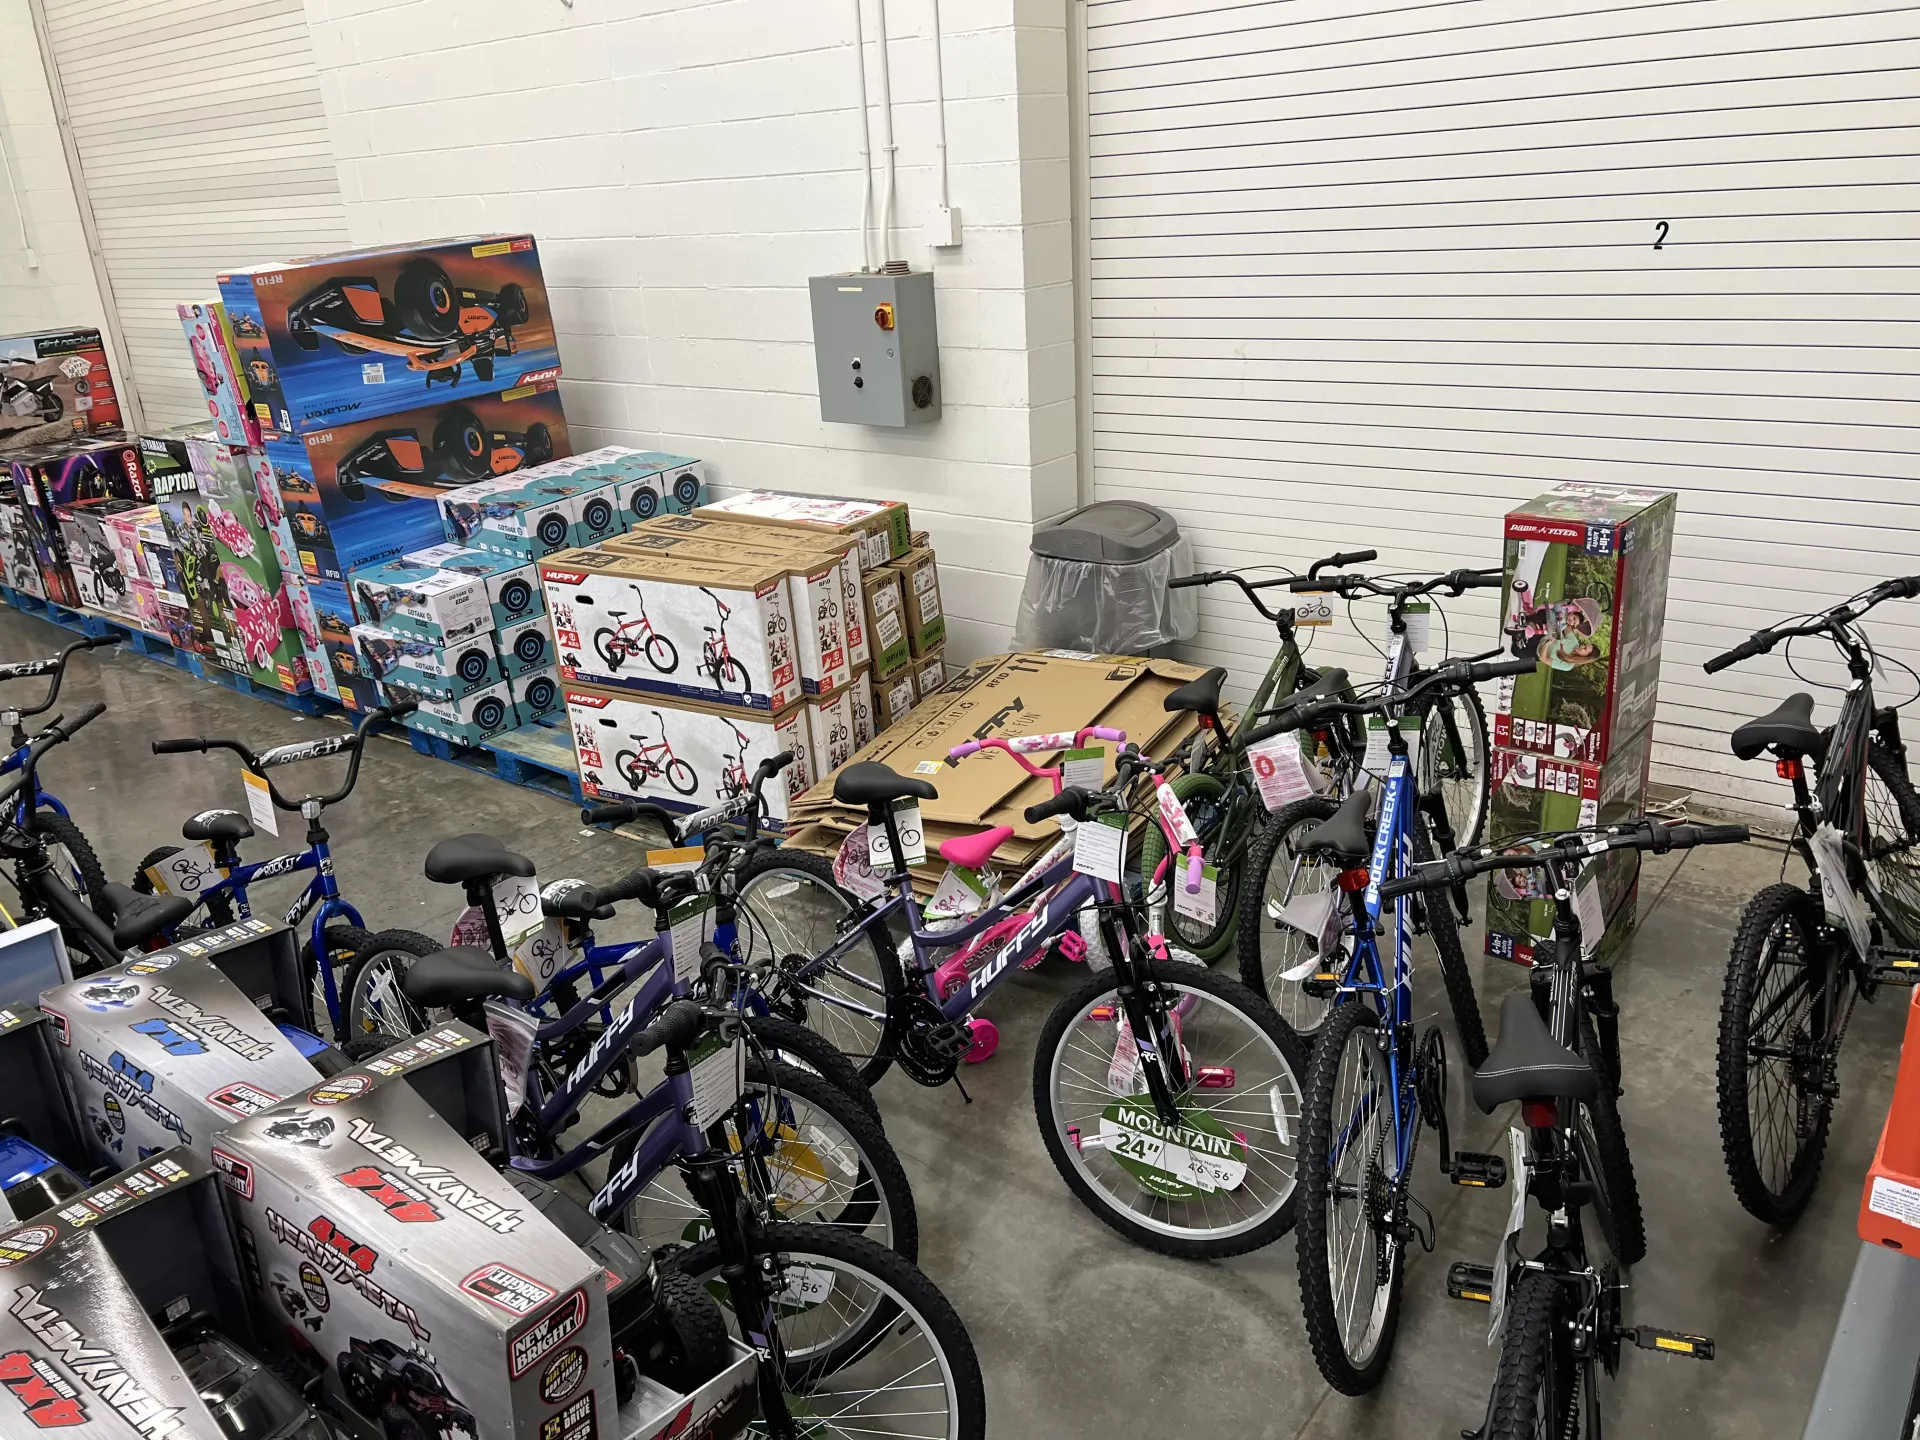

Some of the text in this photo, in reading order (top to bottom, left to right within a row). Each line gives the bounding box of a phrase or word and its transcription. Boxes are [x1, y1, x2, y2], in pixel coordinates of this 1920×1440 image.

[1653, 220, 1670, 251] 2
[256, 274, 283, 286] RFID
[523, 369, 557, 384] HUFFY
[305, 401, 362, 419] McLaren
[309, 433, 333, 446] RFID
[127, 462, 143, 499] Razor
[153, 472, 196, 494] RAPTOR
[504, 534, 518, 542] EDGE
[1509, 524, 1579, 537] RADIO FLYER
[1599, 528, 1611, 554] 4-in-1
[353, 545, 404, 567] McLaren
[918, 557, 930, 569] RFID
[325, 569, 340, 579] RFID
[546, 571, 579, 581] HUFFY
[809, 570, 828, 582] HUFFY
[758, 584, 775, 598] HUFFY
[819, 579, 831, 588] RFID
[877, 578, 893, 590] RFID
[455, 596, 470, 605] EDGE
[925, 636, 943, 653] HUFFY
[831, 659, 842, 669] BUILD
[886, 660, 907, 677] HUFFY
[577, 674, 592, 683] ROCK
[782, 672, 793, 683] BUILD
[985, 672, 1010, 689] RFID
[1381, 656, 1396, 697] CREEK
[569, 694, 603, 705] HUFFY
[822, 698, 840, 710] HUFFY
[777, 717, 794, 731] HUFFY
[1014, 711, 1042, 728] FUN
[1499, 725, 1509, 736] 1-5
[279, 742, 344, 765] ROCK IT
[1584, 777, 1594, 789] 1-5
[699, 800, 748, 832] ROCK IT
[1369, 846, 1387, 894] ROCK
[1378, 790, 1398, 847] CREEK
[264, 857, 297, 877] ROCK IT
[1076, 862, 1096, 872] HUFFY
[1177, 902, 1193, 912] HUFFY
[671, 911, 695, 924] MOUNTAIN
[970, 904, 1050, 999] HUFFY
[1492, 933, 1501, 955] 4-in-1
[677, 965, 693, 977] HUFFY
[148, 984, 275, 1062] HEAVY METAL
[566, 998, 635, 1094] HUFFY
[690, 1047, 717, 1066] MOUNTAIN
[79, 1049, 192, 1145] HEAVY METAL
[701, 1108, 720, 1125] HUFFY
[1117, 1106, 1232, 1157] MOUNTAIN
[1116, 1132, 1161, 1160] 24"
[214, 1155, 233, 1173] NEW
[1203, 1160, 1222, 1169] Height
[347, 1116, 525, 1234] HEAVY METAL
[1149, 1174, 1184, 1189] HUFFY
[1213, 1169, 1234, 1181] 5'6"
[1886, 1188, 1920, 1201] PROPOSITION
[265, 1206, 432, 1344] HEAVY METAL
[791, 1272, 810, 1281] Height
[801, 1281, 822, 1294] 5'6"
[493, 1290, 535, 1311] NEW
[9, 1283, 114, 1364] METAL
[515, 1318, 550, 1356] NEW
[545, 1354, 584, 1398] BODY PANELS
[546, 1351, 577, 1386] REAL STEEL
[563, 1396, 590, 1419] 4-WHEEL
[564, 1403, 591, 1430] DRIVE
